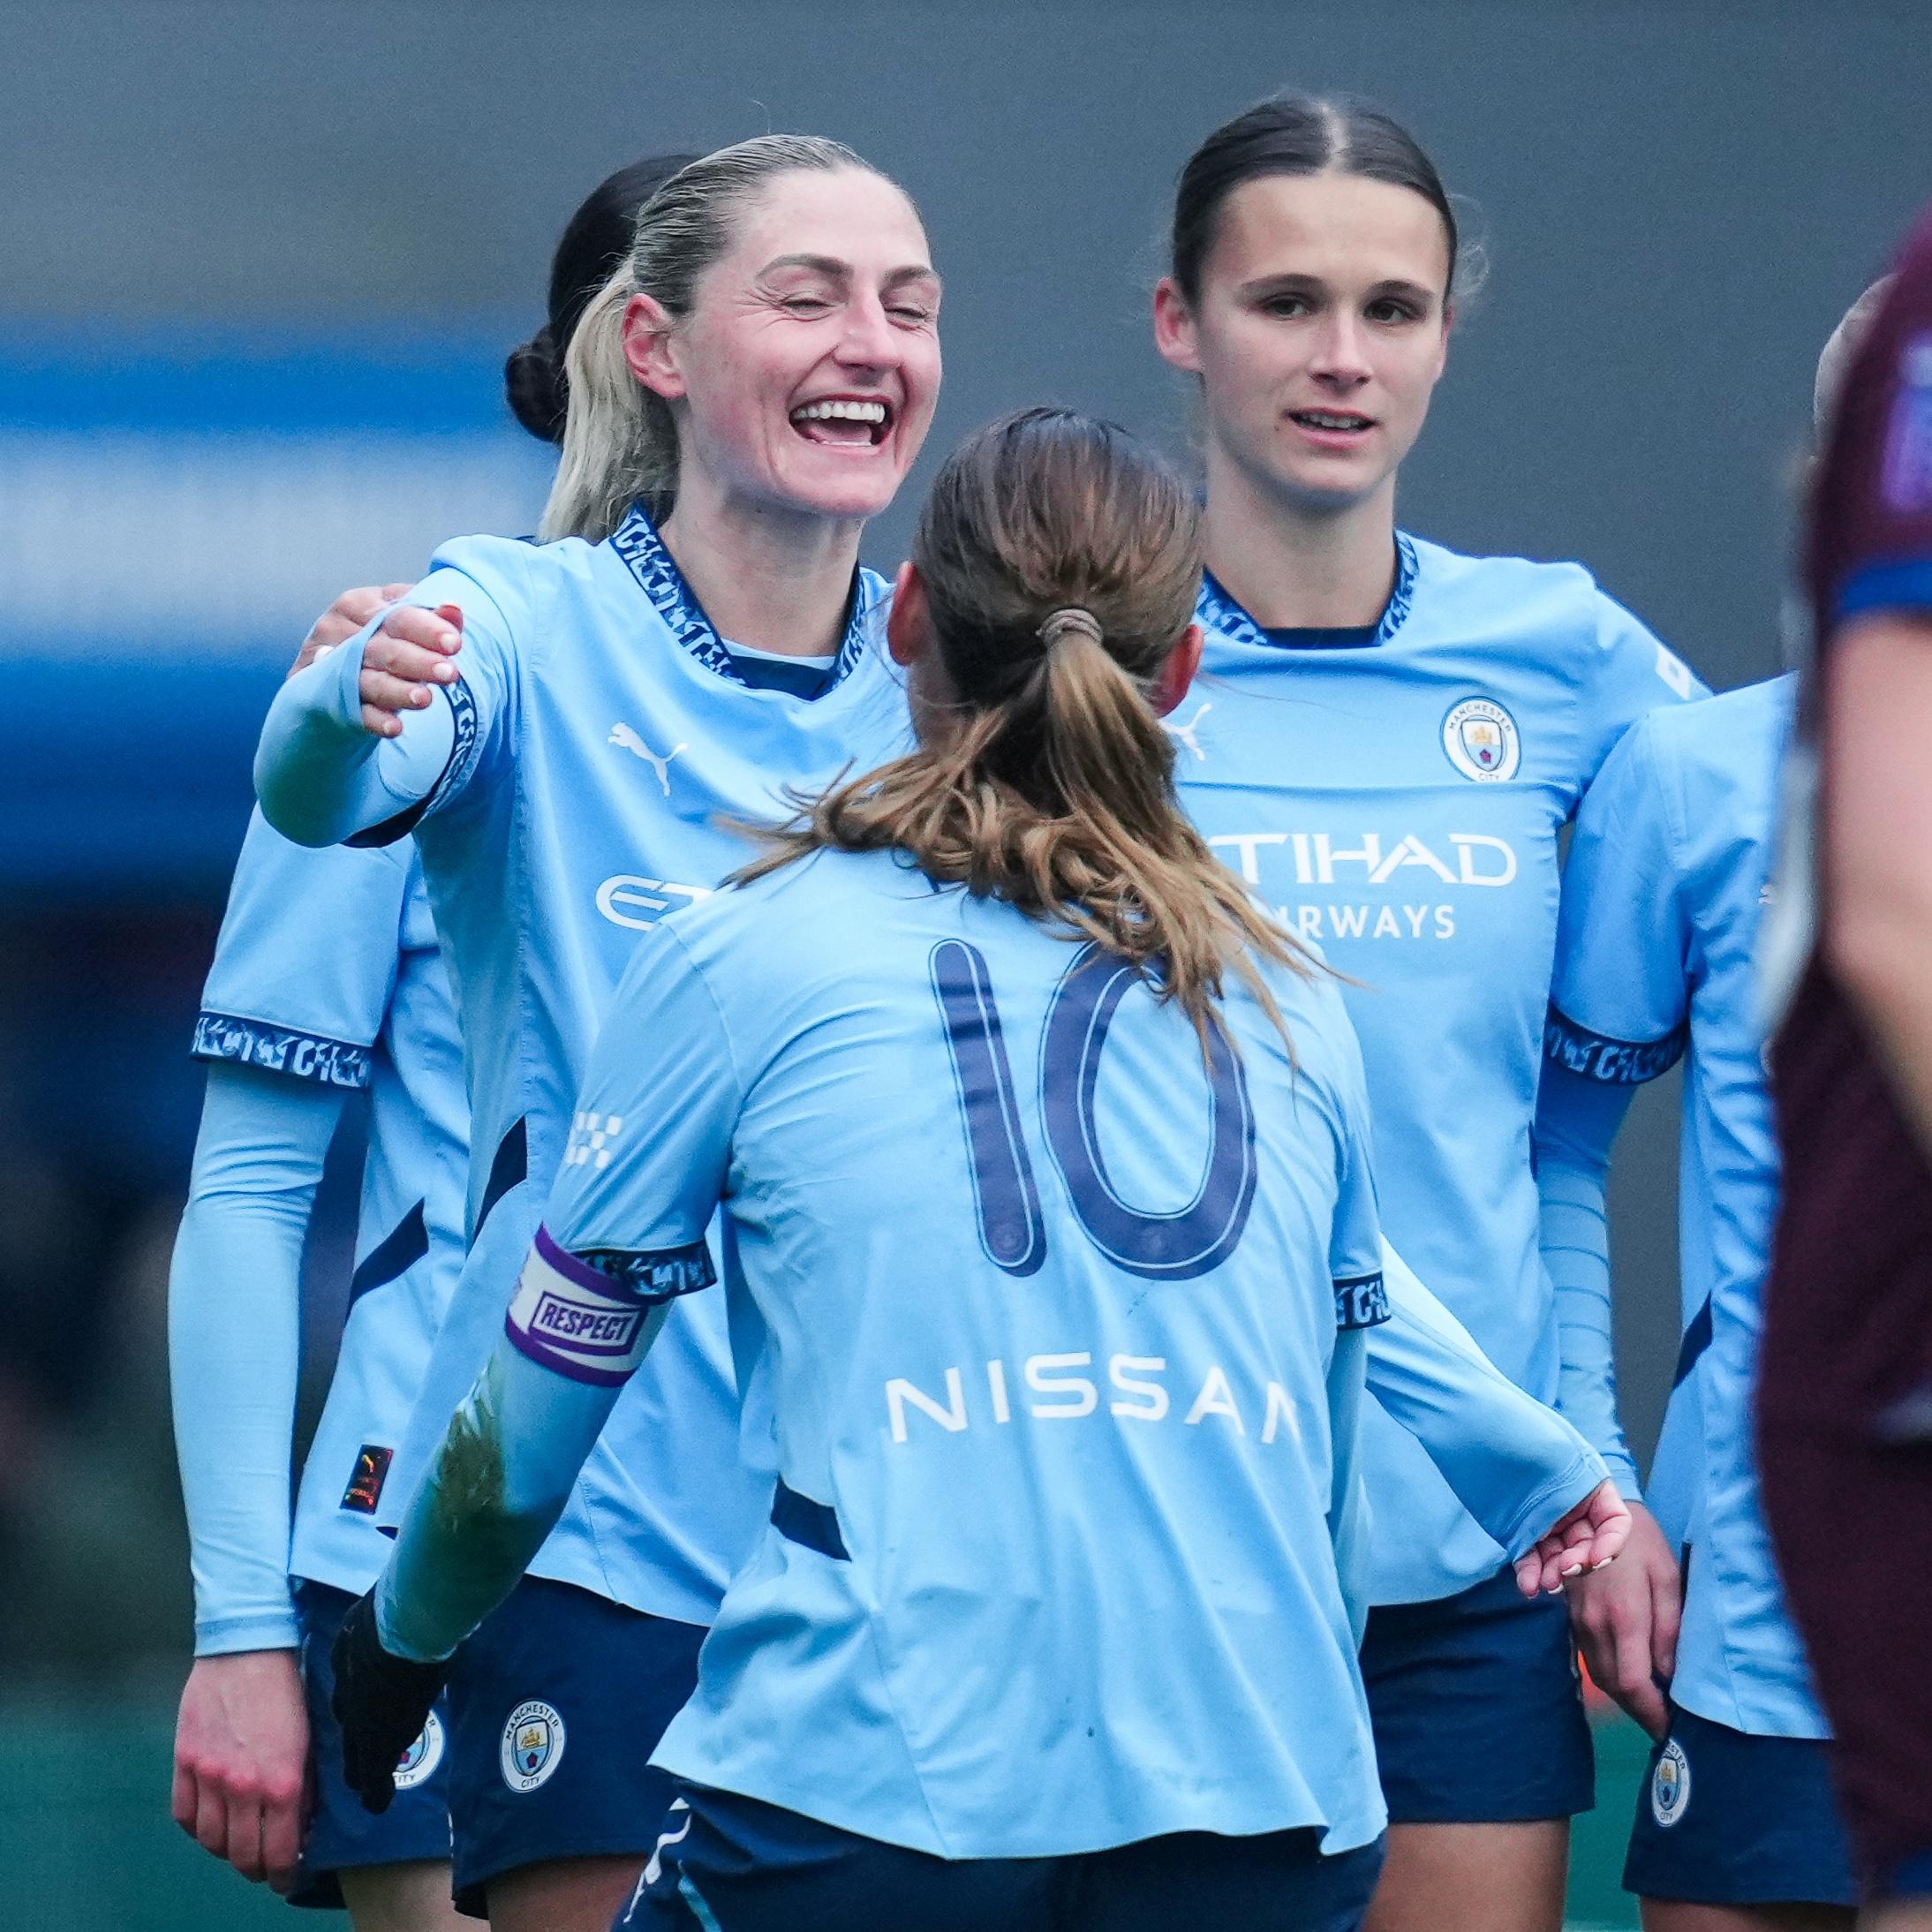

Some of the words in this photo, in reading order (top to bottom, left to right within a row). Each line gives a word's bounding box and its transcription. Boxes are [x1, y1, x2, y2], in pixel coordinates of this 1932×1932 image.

[1209, 833, 1518, 887] TIHAD
[1279, 904, 1455, 940] RWAYS
[928, 938, 1257, 1281] 10
[540, 1302, 630, 1341] RESPECT
[506, 1704, 559, 1740] MANCHESTER
[521, 1776, 540, 1788] CITY
